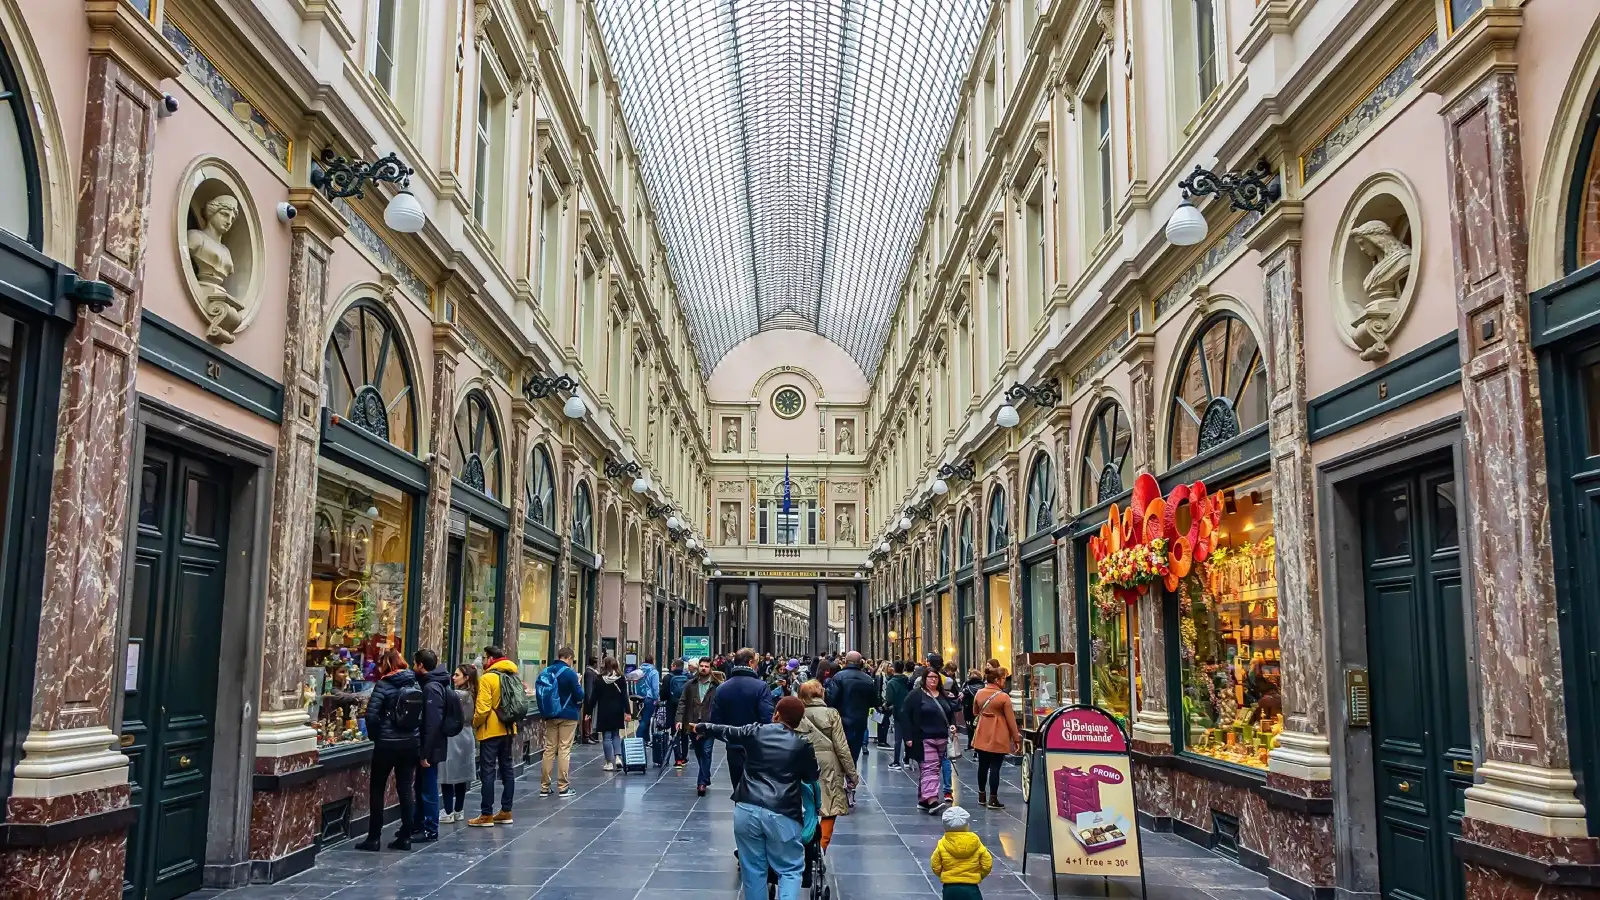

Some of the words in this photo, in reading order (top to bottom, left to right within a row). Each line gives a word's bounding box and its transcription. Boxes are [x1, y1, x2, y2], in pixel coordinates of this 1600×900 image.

[207, 360, 220, 379] 20
[1377, 382, 1387, 399] 15
[1062, 718, 1071, 728] la
[1070, 718, 1109, 734] Belgique
[1061, 728, 1112, 743] Gourmande
[1093, 767, 1120, 780] PROMO
[1086, 857, 1104, 866] free
[1115, 859, 1129, 867] 30€
